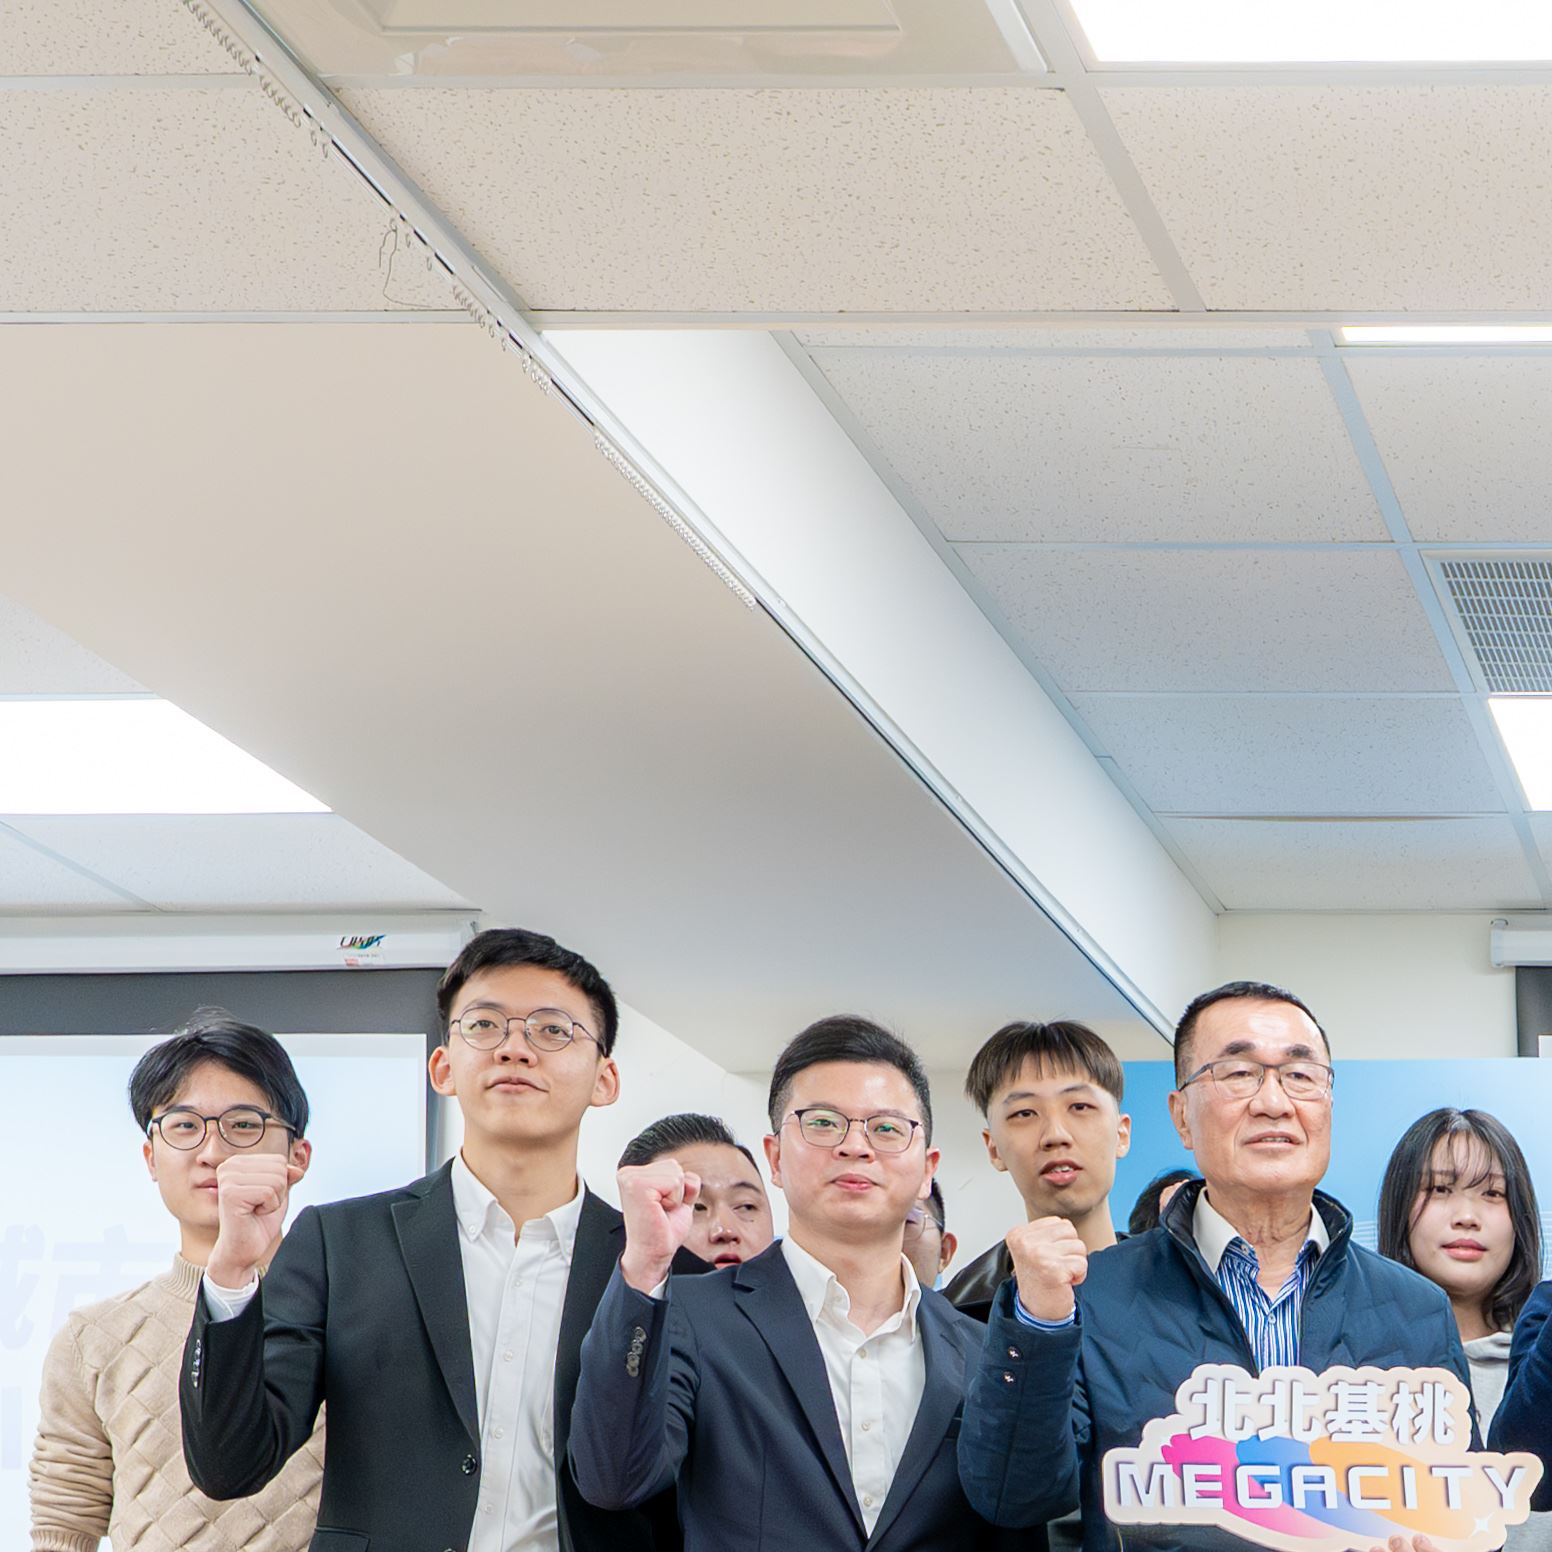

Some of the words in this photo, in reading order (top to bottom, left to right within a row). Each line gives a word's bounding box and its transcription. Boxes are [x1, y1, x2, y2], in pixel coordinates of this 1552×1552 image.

[1189, 1379, 1455, 1445] 北北基桃
[1118, 1462, 1527, 1511] MEGACITY
